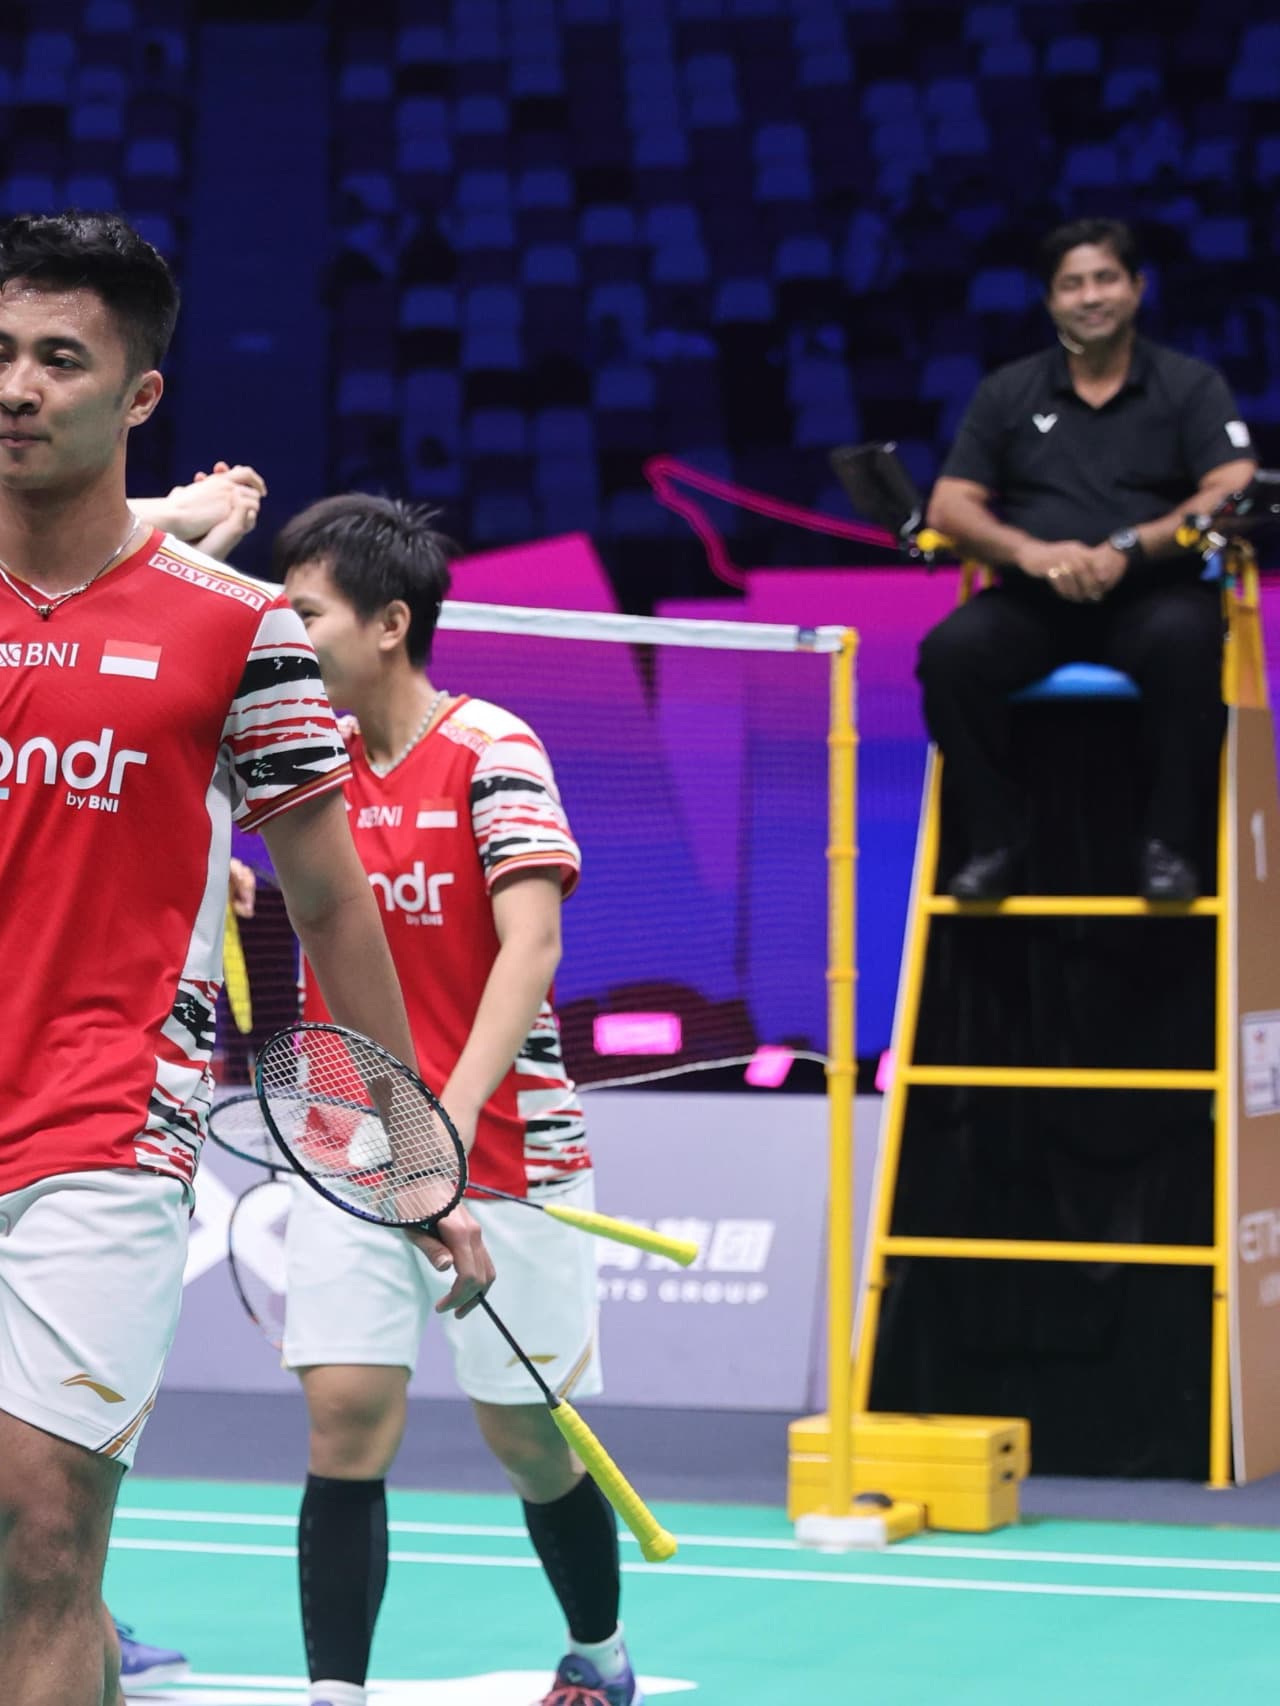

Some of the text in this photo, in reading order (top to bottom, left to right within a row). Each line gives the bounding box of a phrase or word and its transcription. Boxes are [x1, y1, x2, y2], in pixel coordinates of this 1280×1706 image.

[153, 556, 261, 607] POLYTRON
[24, 642, 80, 667] BNI
[66, 792, 119, 813] by BNI
[367, 861, 454, 913] ndr
